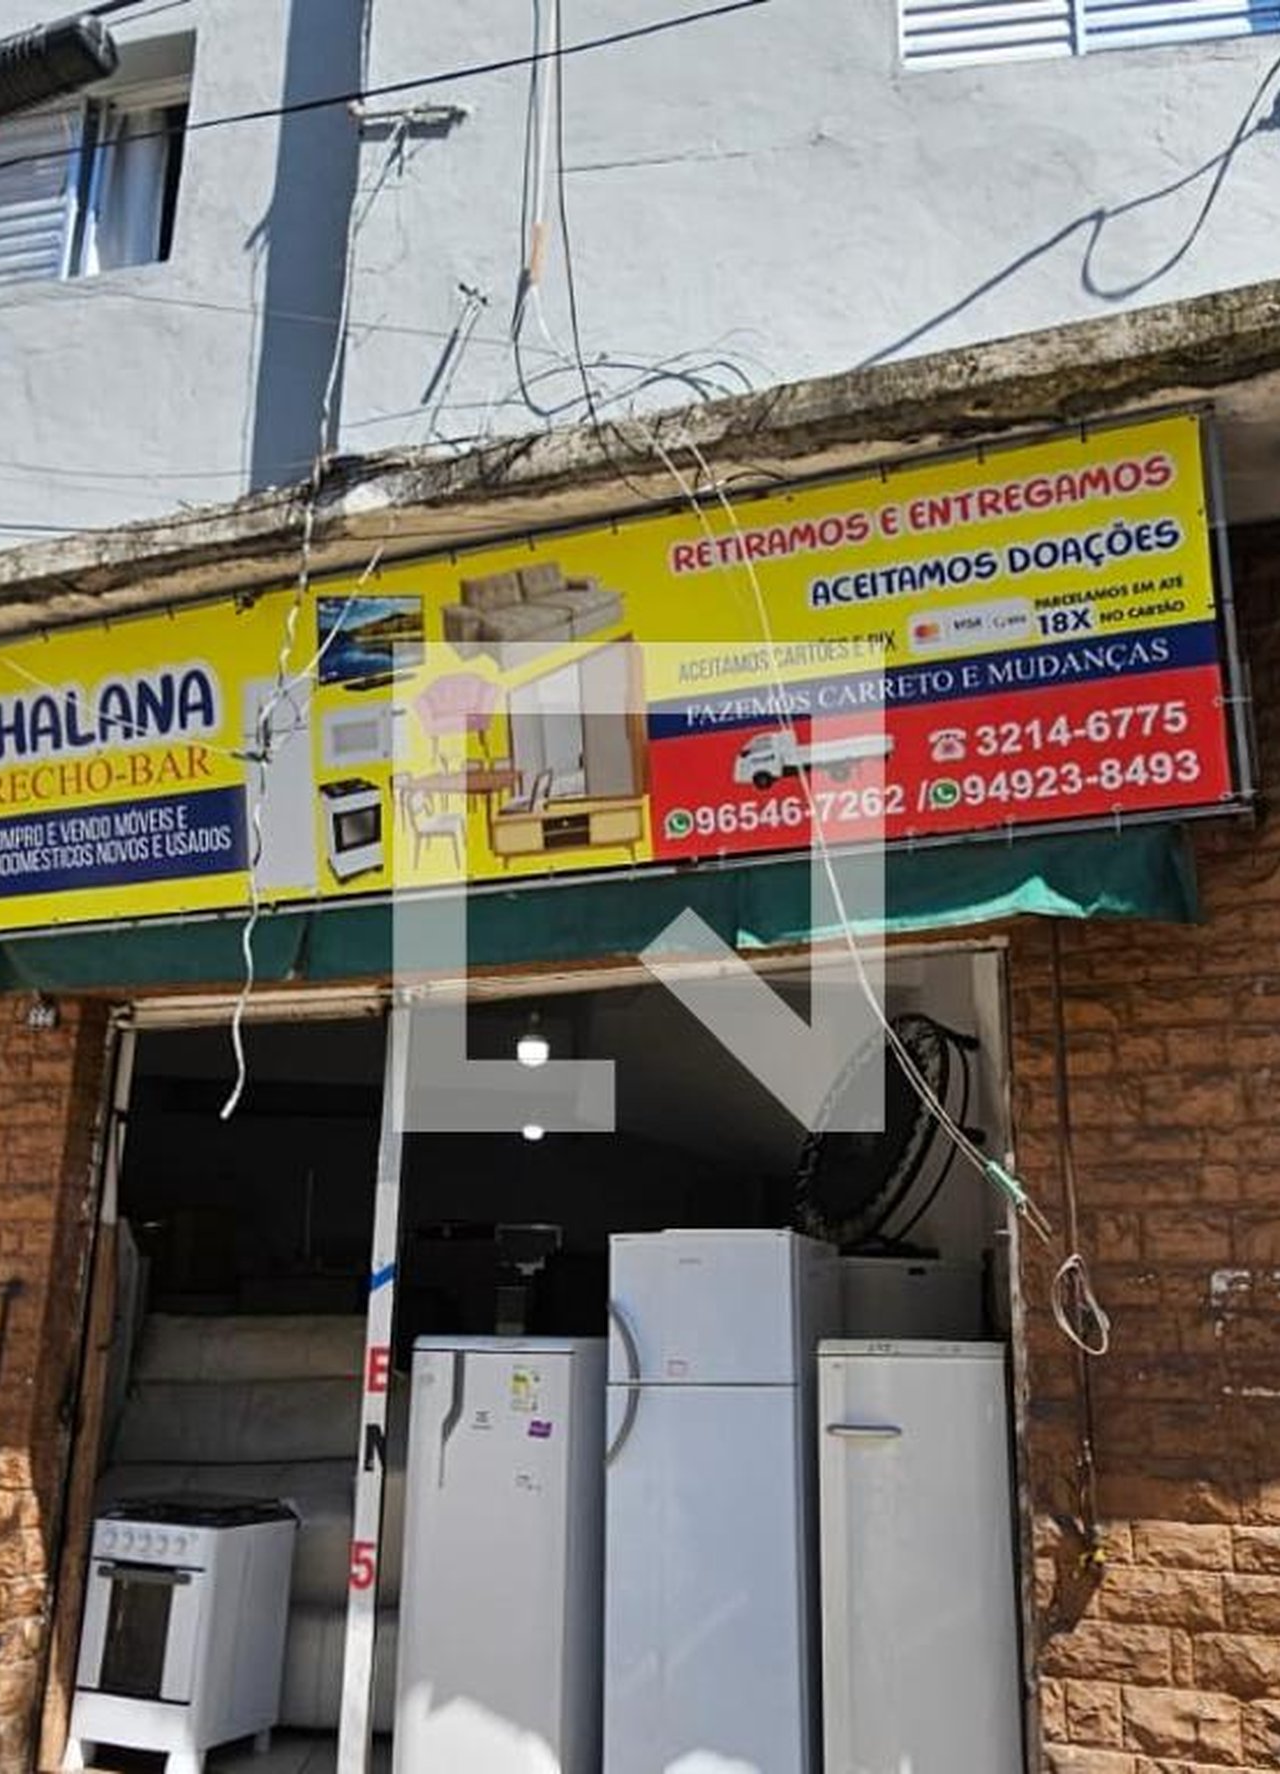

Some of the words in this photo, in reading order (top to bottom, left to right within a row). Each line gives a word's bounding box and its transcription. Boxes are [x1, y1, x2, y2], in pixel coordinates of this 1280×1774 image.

[673, 512, 870, 572] RETIRAMOS
[880, 506, 899, 536] E
[909, 455, 1172, 531] ENTREGAMOS
[811, 551, 998, 607] ACEITAMOS
[1007, 520, 1180, 568] DOAÇÕES
[1036, 607, 1092, 636] 18X
[1099, 609, 1124, 624] NO
[678, 649, 771, 685] ACEITAMOS
[867, 629, 896, 655] PIX
[685, 688, 812, 727] FAZEMOS
[816, 670, 954, 709] CARRETO
[962, 667, 979, 688] E
[988, 637, 1170, 686] MUDANÇAS
[975, 701, 1188, 757] 3214-6775
[695, 783, 906, 836] 96546-7262
[962, 749, 1201, 805] 94923-8493
[47, 820, 58, 842] E
[60, 815, 113, 842] VENDO
[114, 805, 175, 835] MÓVEIS
[177, 804, 189, 828] E
[95, 836, 150, 865] NOVOS
[151, 833, 164, 857] E
[164, 824, 233, 857] USADOS
